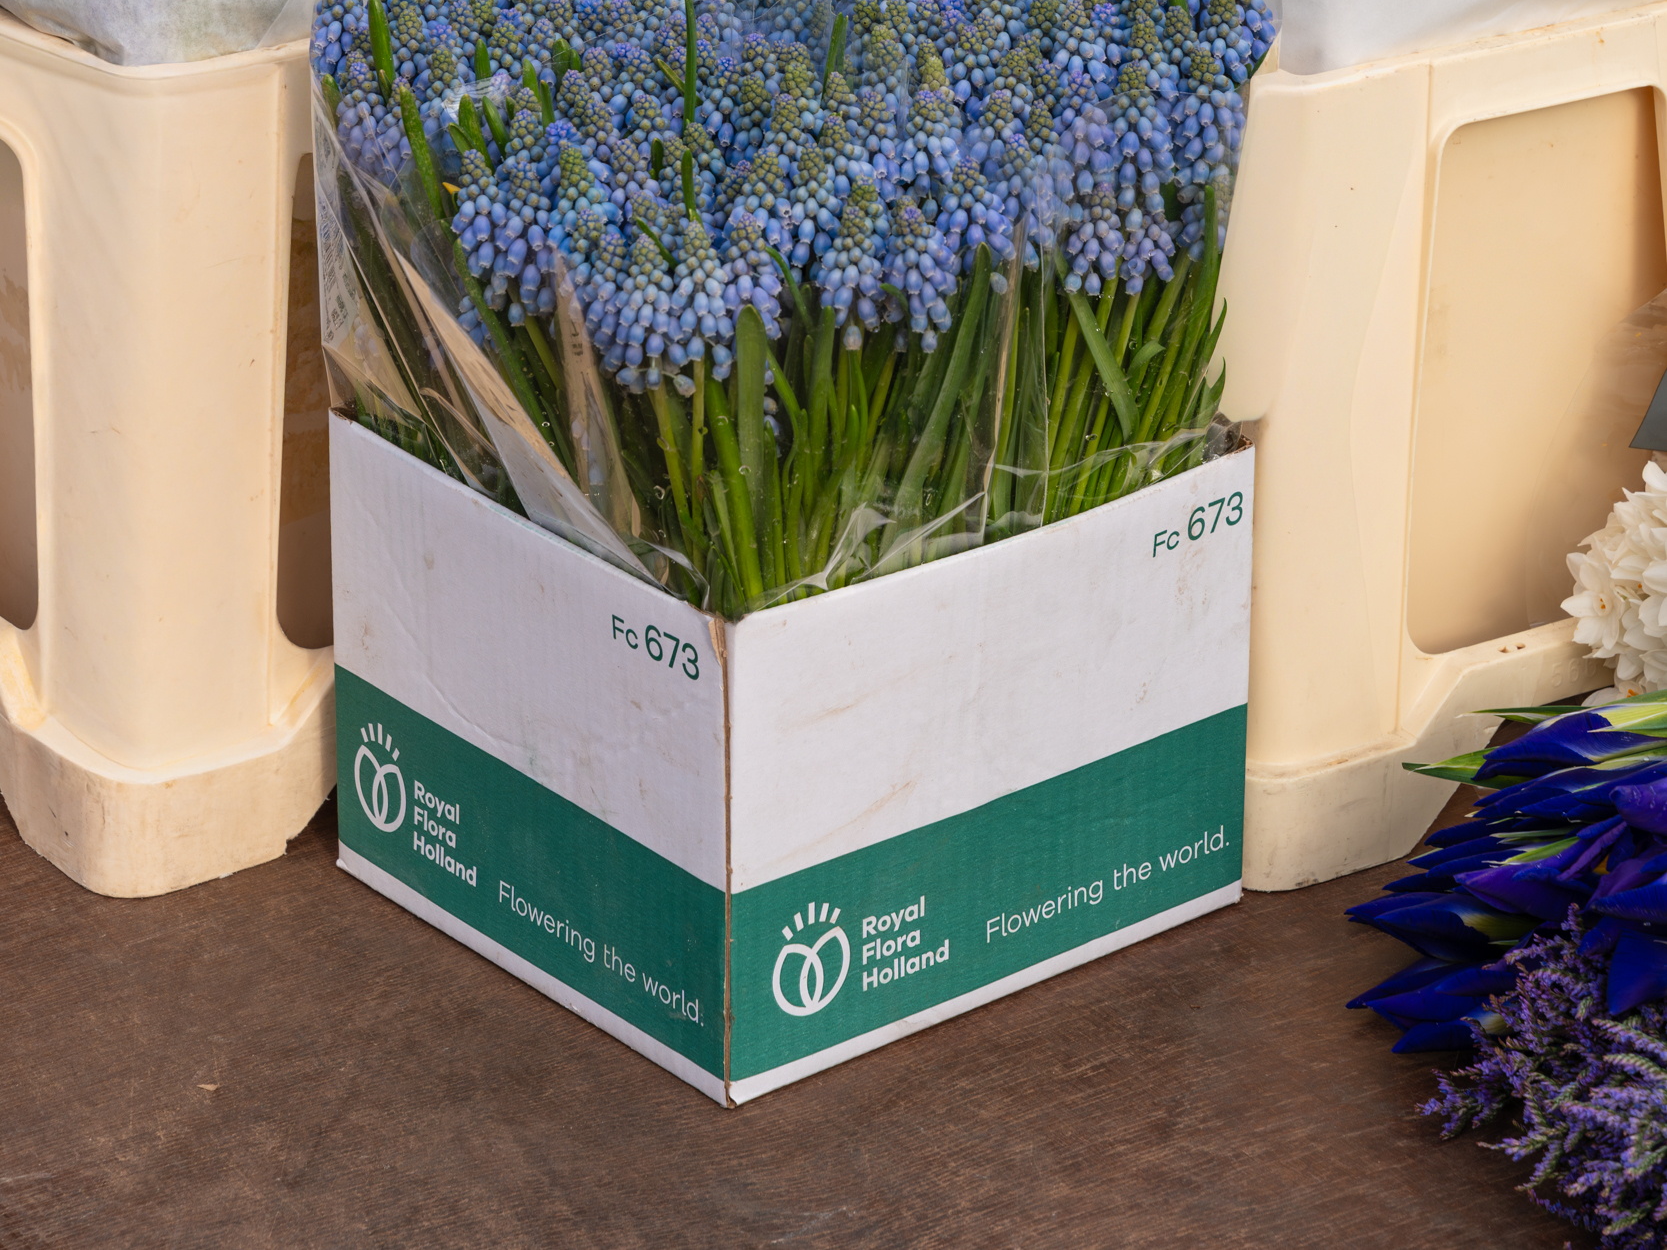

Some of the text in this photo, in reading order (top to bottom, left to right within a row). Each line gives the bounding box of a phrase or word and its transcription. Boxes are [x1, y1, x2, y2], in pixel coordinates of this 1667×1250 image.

[1153, 491, 1243, 558] Fc 673
[612, 614, 699, 681] Fc 673
[414, 780, 460, 825] Royal
[414, 806, 456, 848] Flora
[413, 831, 477, 887] Holland
[986, 825, 1230, 944] Flowering the world.
[862, 896, 926, 938] Royal
[500, 880, 704, 1027] Flowering the world.
[862, 928, 921, 965] Flora
[862, 939, 950, 991] Holland
